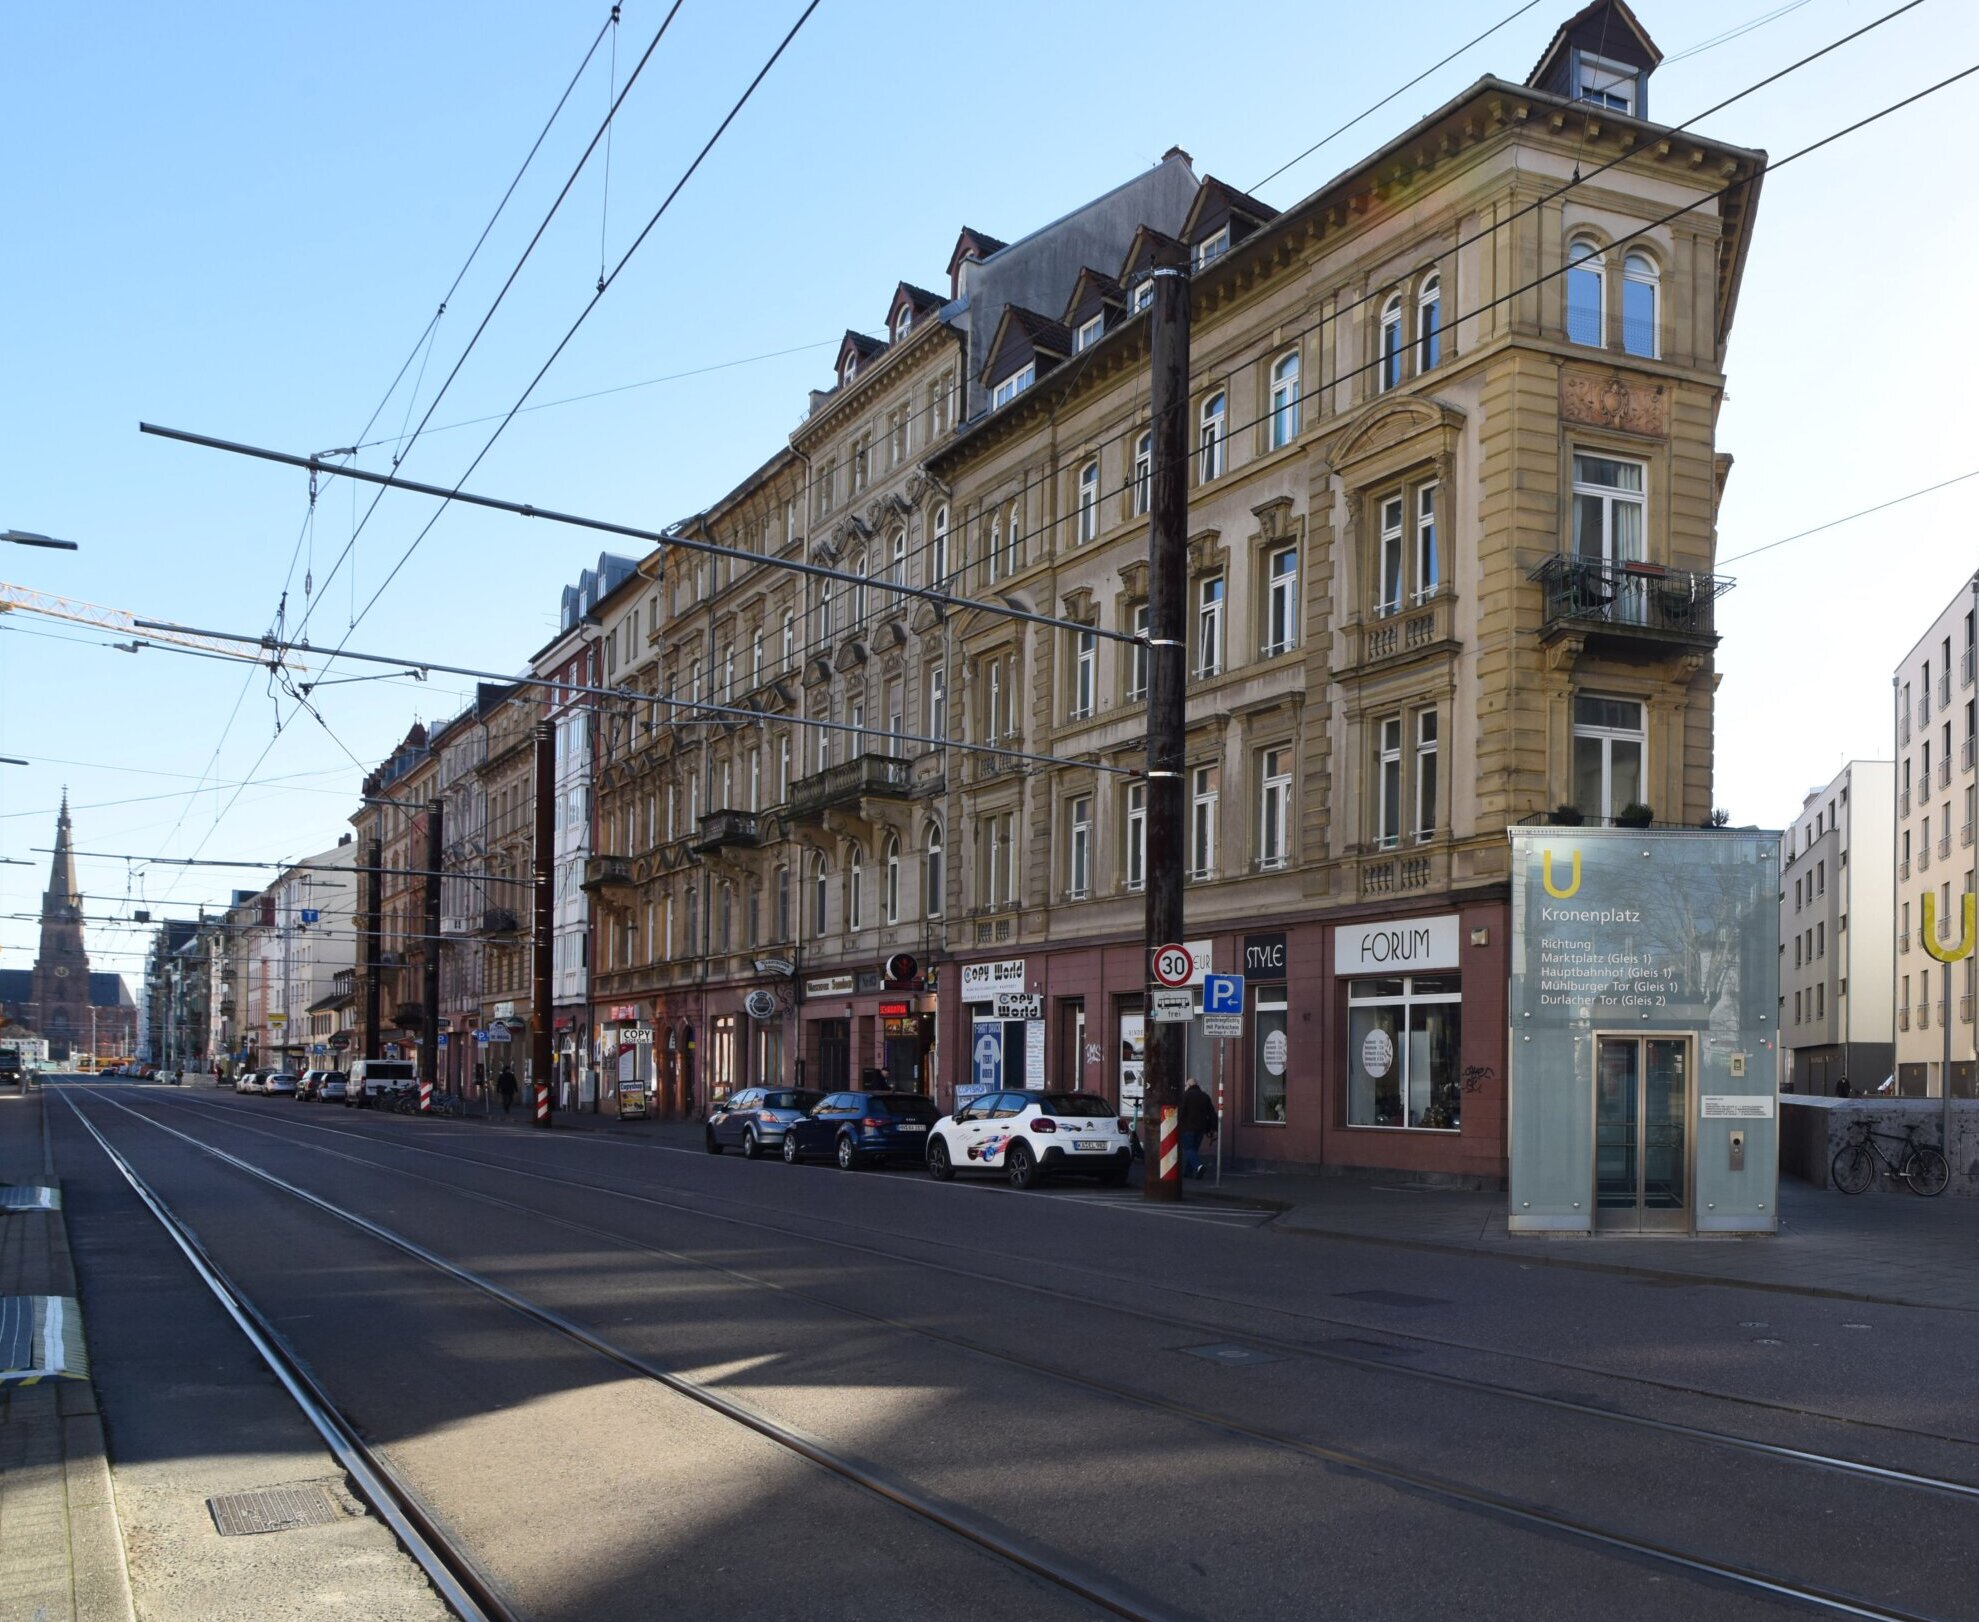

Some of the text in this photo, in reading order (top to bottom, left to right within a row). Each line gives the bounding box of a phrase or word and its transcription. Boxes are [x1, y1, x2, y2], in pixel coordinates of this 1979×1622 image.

[1543, 848, 1582, 899] U
[1542, 908, 1640, 925] Kronenplatz
[1921, 892, 1977, 962] U
[1361, 928, 1430, 963] FORUM
[1541, 939, 1591, 951] Richtung
[1247, 944, 1283, 969] STYLE
[1541, 953, 1652, 965] Marktplatz (Gleis 1)
[964, 961, 1023, 983] Copy World
[1162, 956, 1185, 975] 30
[1541, 967, 1672, 979] Hauptbahnhof (Gleis 1)
[1212, 979, 1234, 1009] P
[1541, 981, 1678, 993] Mühlburger Tor (Gleis 1)
[999, 993, 1034, 1005] Copy
[1541, 995, 1666, 1007] Durlacher Tor (Gleis 2)
[998, 1005, 1038, 1017] World
[623, 1029, 651, 1039] COPY
